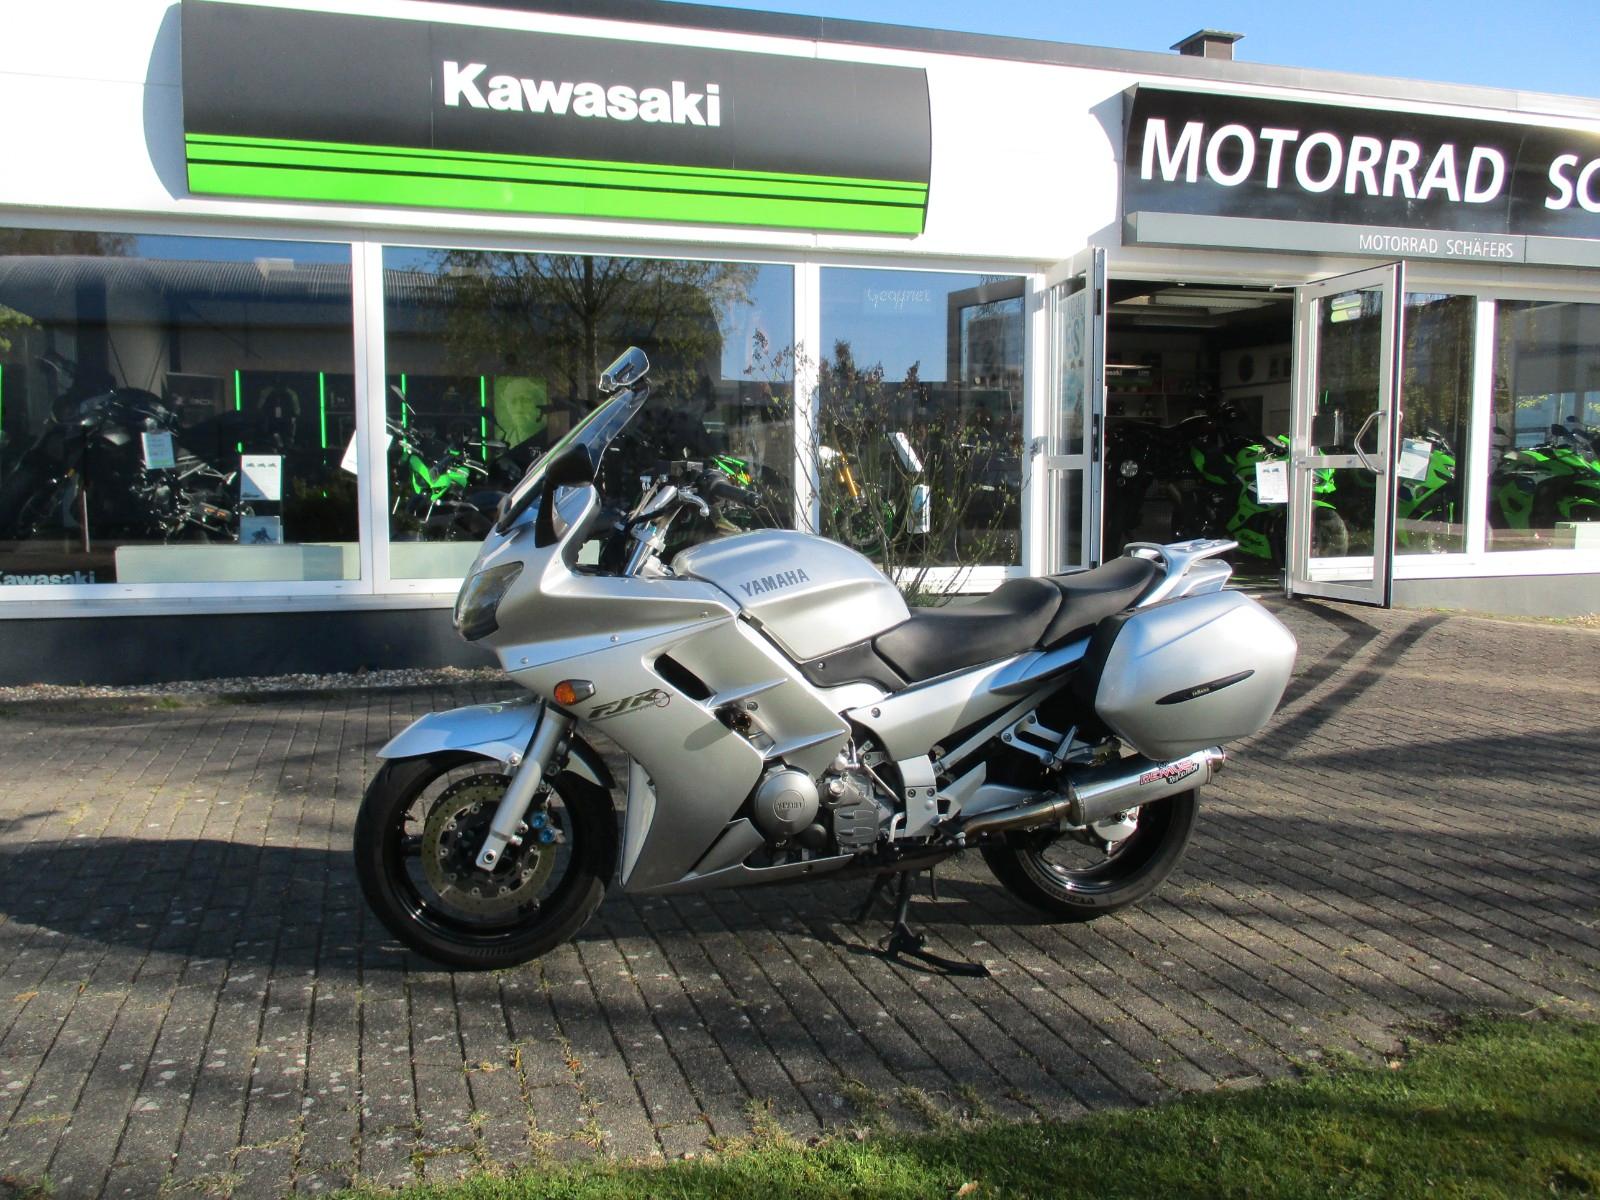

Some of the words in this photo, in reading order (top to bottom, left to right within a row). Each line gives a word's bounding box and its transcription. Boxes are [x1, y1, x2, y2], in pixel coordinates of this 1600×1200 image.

[443, 60, 721, 127] Kawasaki
[1140, 117, 1507, 204] MOTORRAD
[1359, 233, 1438, 254] MOTORRAD
[1446, 237, 1514, 258] SCHÄFERS
[0, 570, 96, 585] awasaki
[739, 567, 810, 598] YAMAHA
[1140, 760, 1195, 785] REMUS
